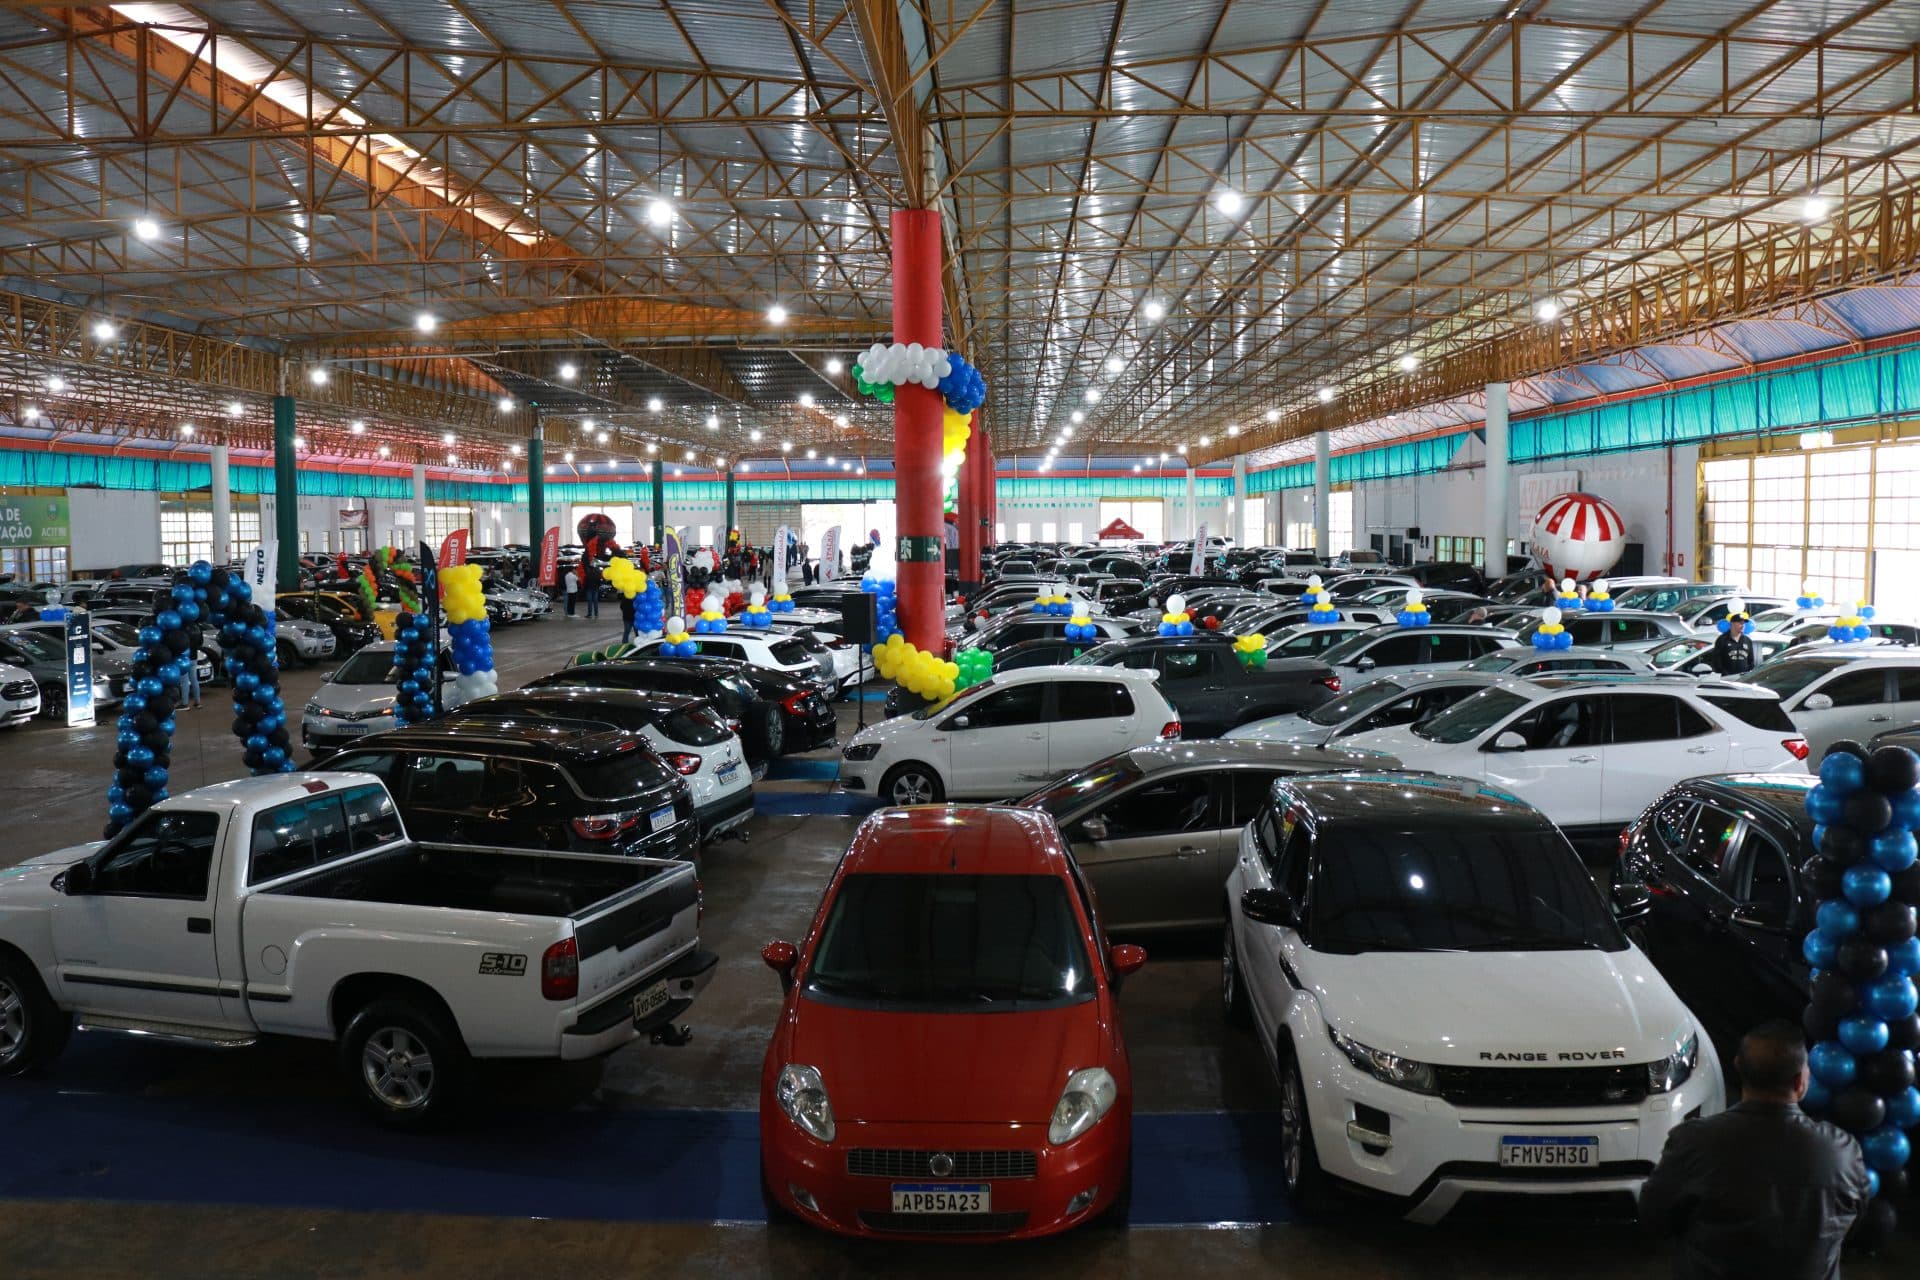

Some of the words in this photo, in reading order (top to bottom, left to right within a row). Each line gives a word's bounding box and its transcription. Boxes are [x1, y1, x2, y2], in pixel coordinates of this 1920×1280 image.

[6, 508, 20, 521] DE
[0, 522, 32, 543] AÇÃO
[482, 953, 527, 969] S-10
[1480, 1052, 1547, 1061] RANGE
[1558, 1050, 1625, 1061] ROVER
[1510, 1146, 1589, 1163] FMV5H30
[902, 1194, 980, 1211] APB5A23
